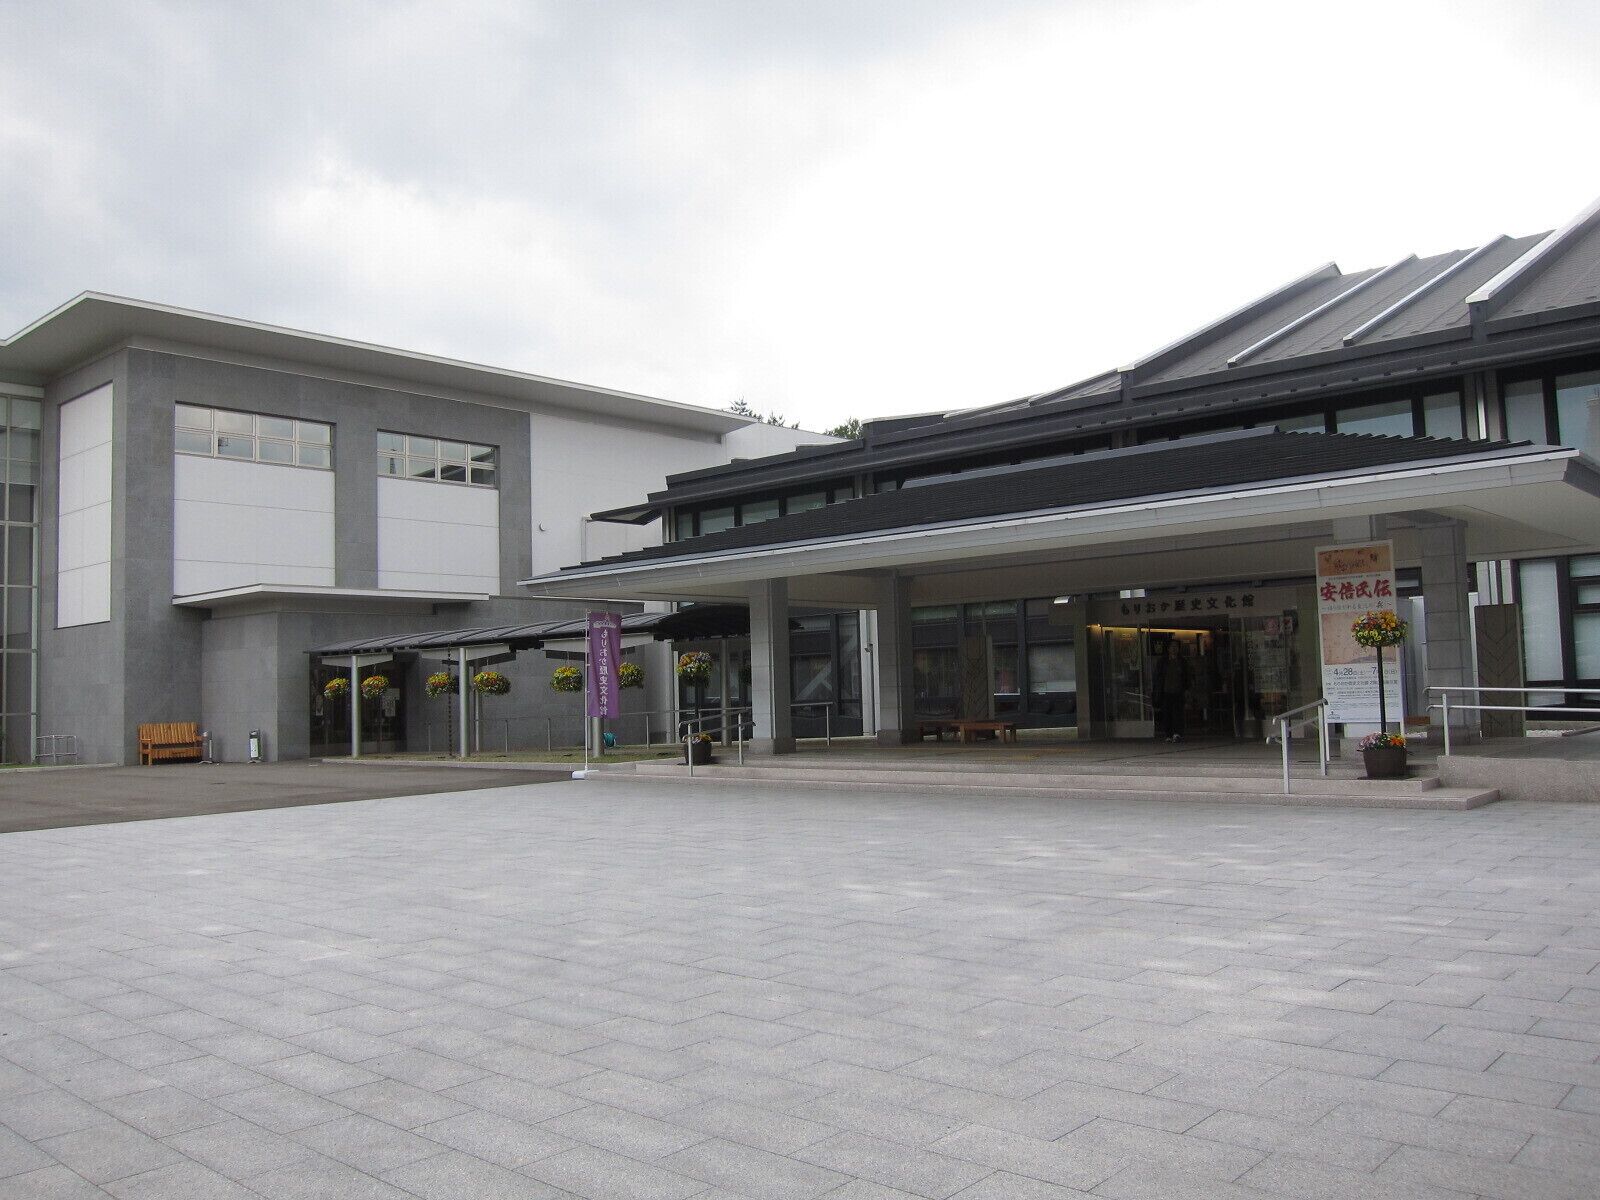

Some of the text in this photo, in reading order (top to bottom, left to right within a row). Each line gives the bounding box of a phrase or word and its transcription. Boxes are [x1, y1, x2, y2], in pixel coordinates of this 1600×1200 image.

[1120, 594, 1255, 615] もりおか歴史文化館
